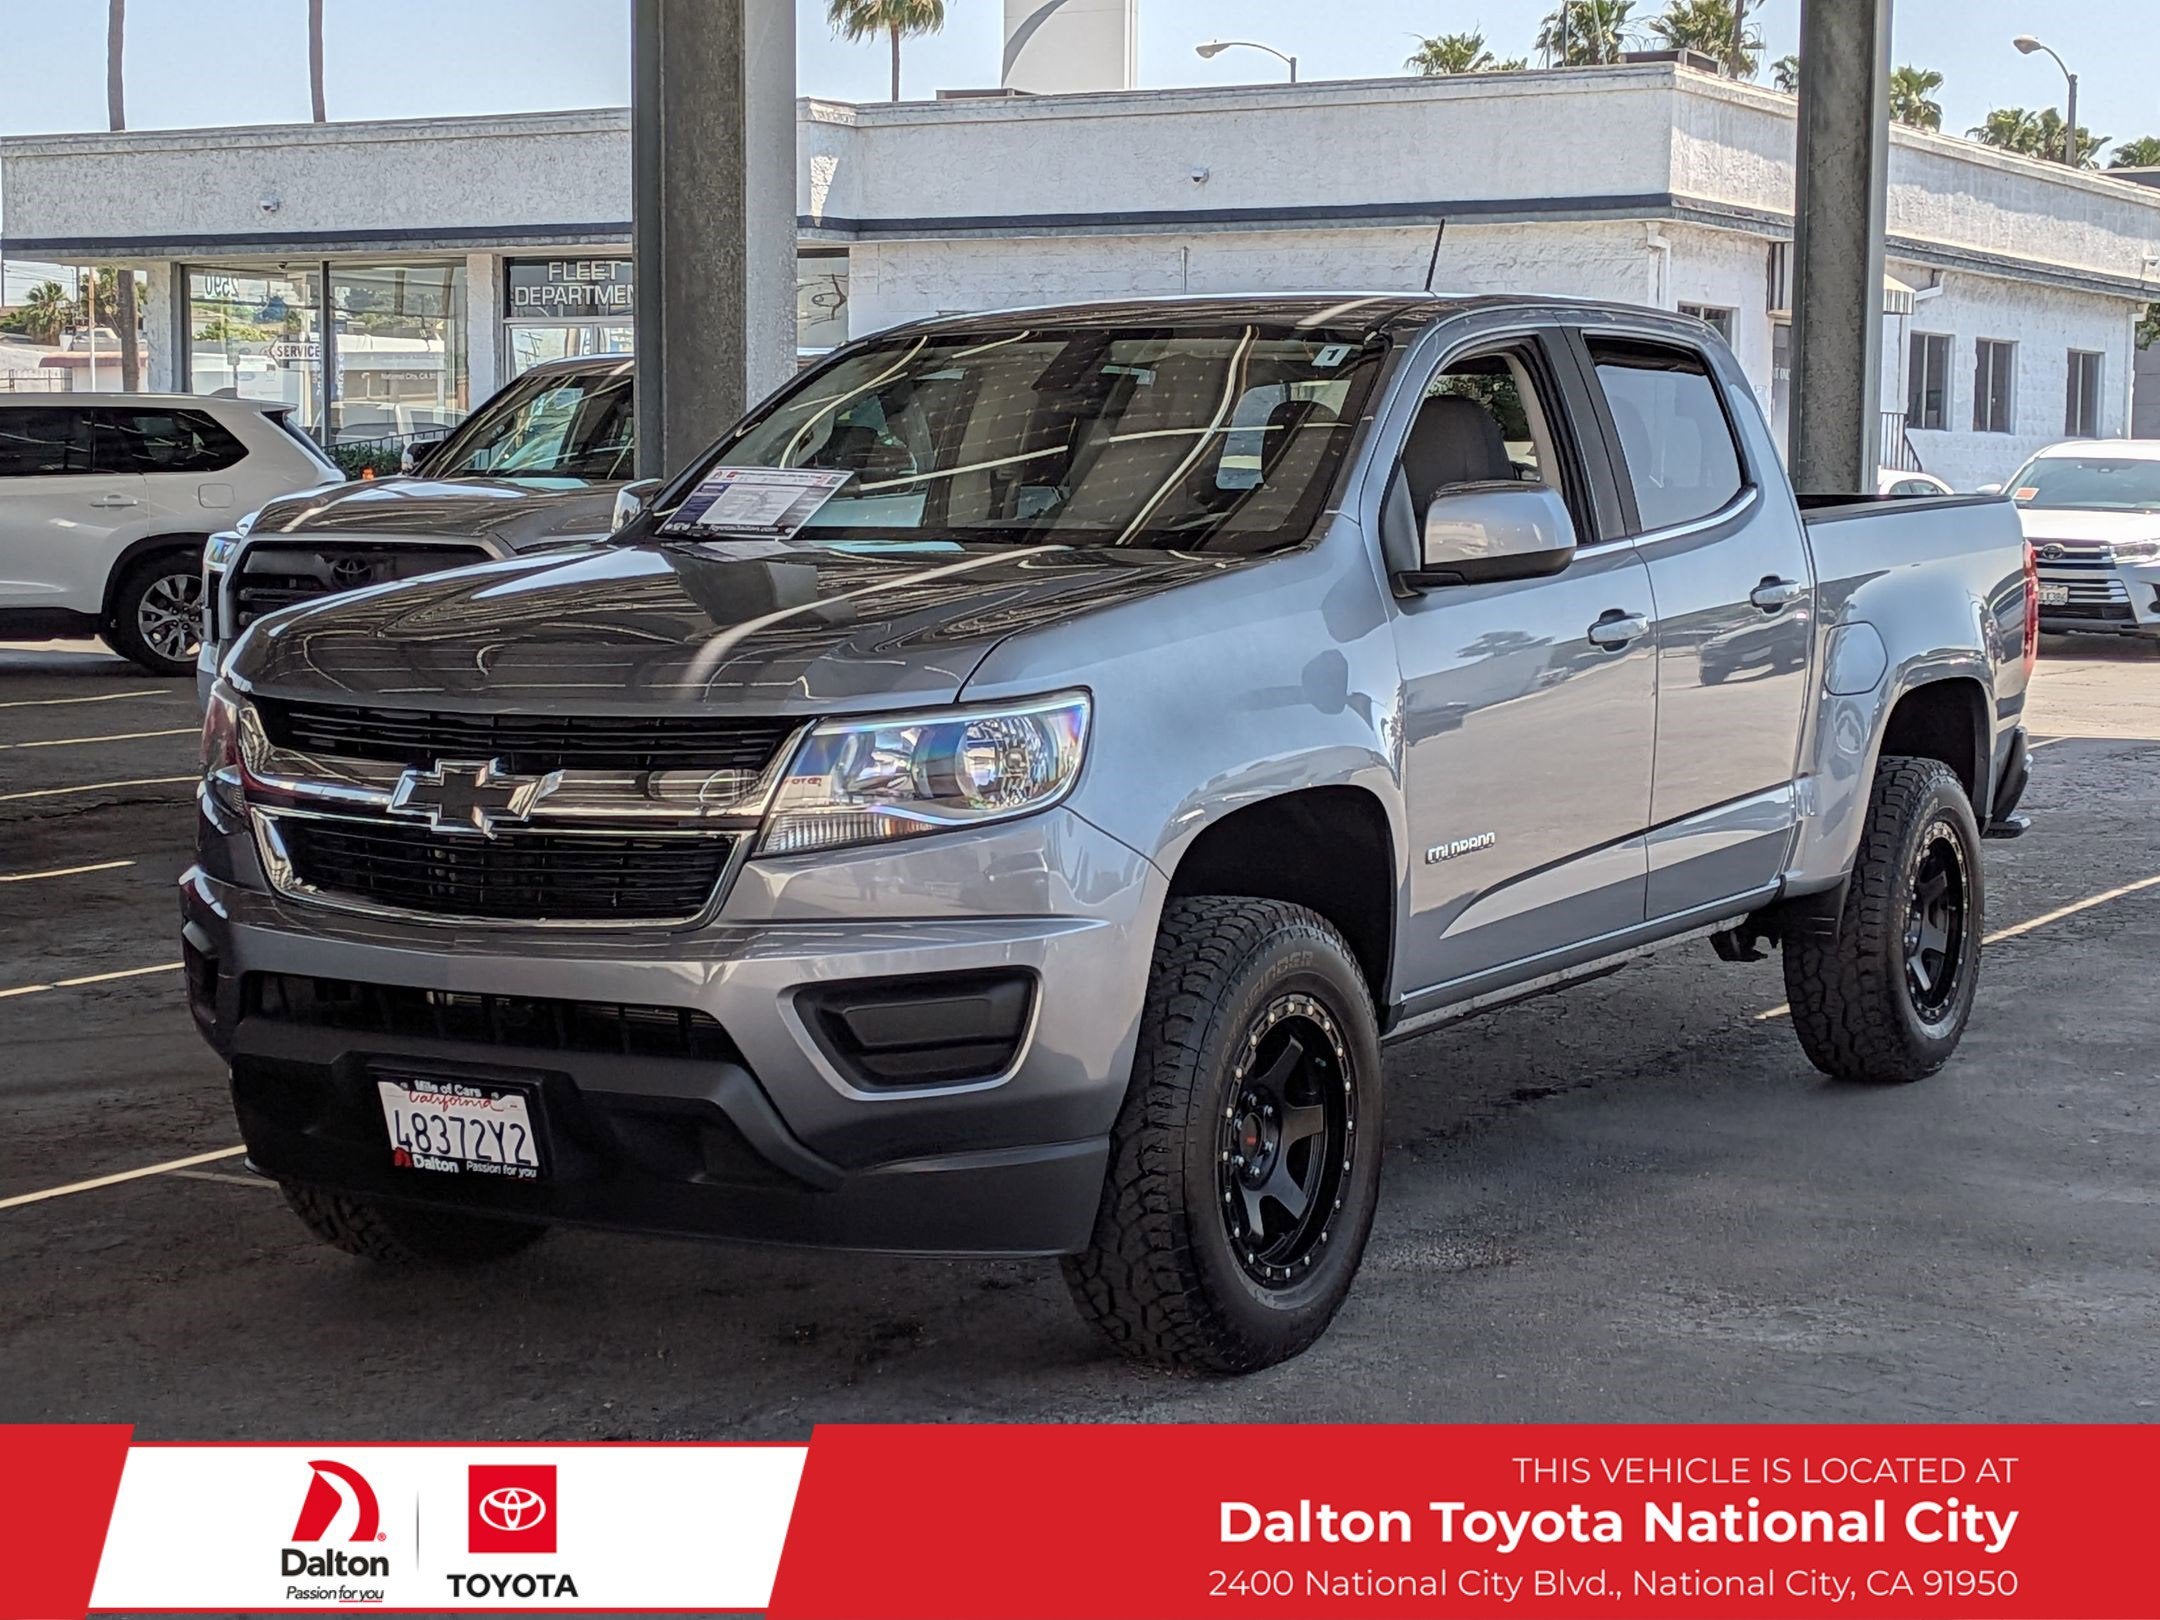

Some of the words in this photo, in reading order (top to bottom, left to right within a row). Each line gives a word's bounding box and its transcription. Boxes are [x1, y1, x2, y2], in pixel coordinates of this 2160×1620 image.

[548, 260, 622, 282] FLEET
[276, 345, 321, 358] SERVICE
[1327, 348, 1340, 361] 1
[440, 1082, 453, 1094] of
[454, 1083, 482, 1098] Cars
[408, 1091, 504, 1112] California
[393, 1110, 532, 1166] 48372Y2
[412, 1153, 460, 1173] Dalton
[466, 1160, 502, 1175] Passion
[502, 1163, 518, 1176] for
[518, 1166, 537, 1179] you
